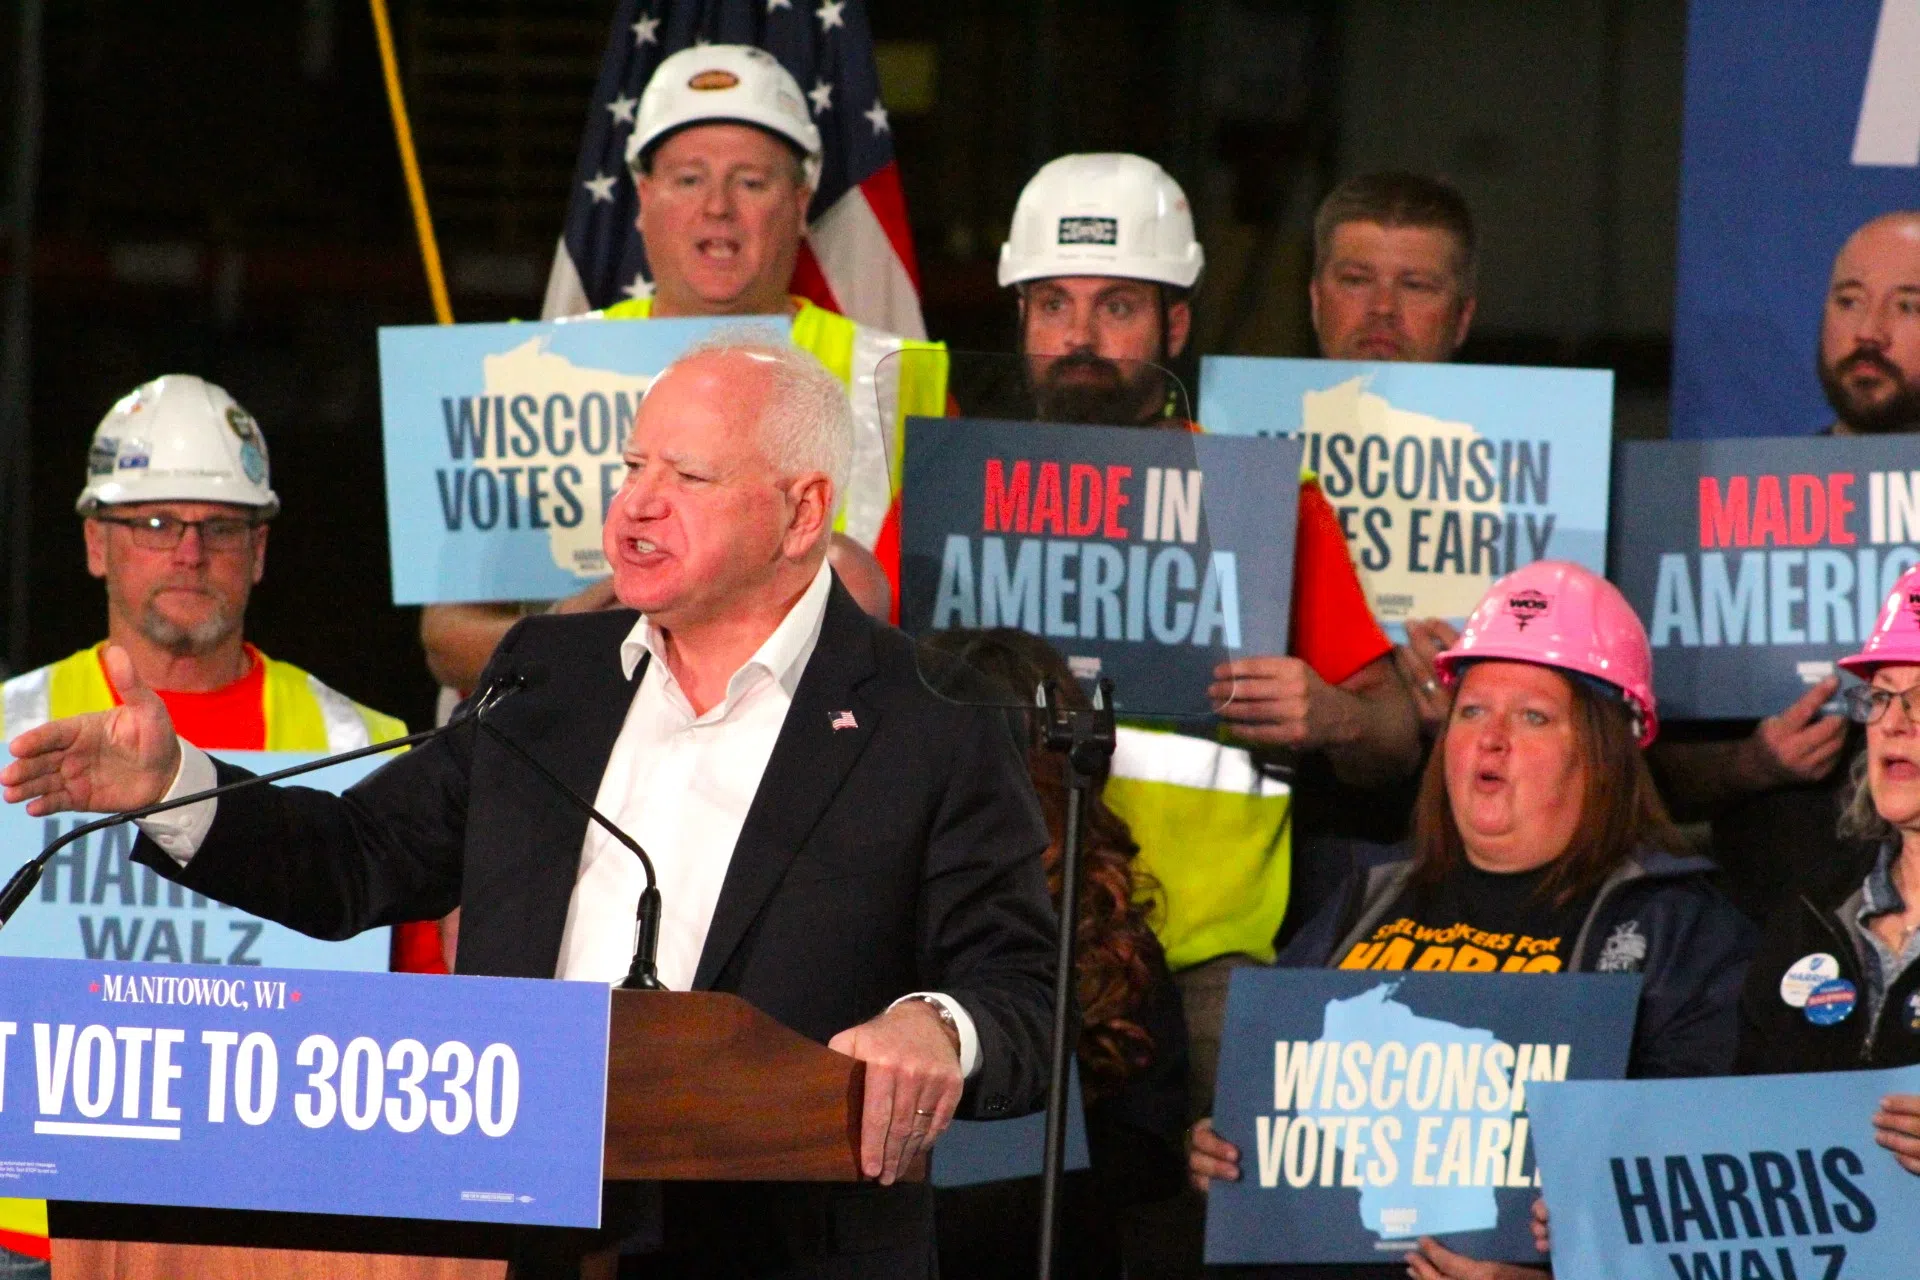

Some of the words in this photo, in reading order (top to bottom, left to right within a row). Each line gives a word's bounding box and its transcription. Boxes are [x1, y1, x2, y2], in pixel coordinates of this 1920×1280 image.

[436, 464, 584, 531] VOTES
[983, 459, 1132, 539] MADE
[1143, 467, 1203, 543] IN
[1698, 473, 1856, 548] MADE
[1868, 471, 1920, 544] IN
[932, 534, 1241, 649] AMERICA
[79, 915, 263, 966] WALZ
[102, 974, 249, 1011] MANITOWOC,
[254, 980, 287, 1009] WI
[33, 1022, 184, 1121] VOTE
[201, 1030, 279, 1126] TO
[294, 1034, 520, 1137] 30330
[1256, 1115, 1403, 1188] VOTES
[1411, 1116, 1542, 1188] EARL
[1609, 1146, 1878, 1245] HARRIS
